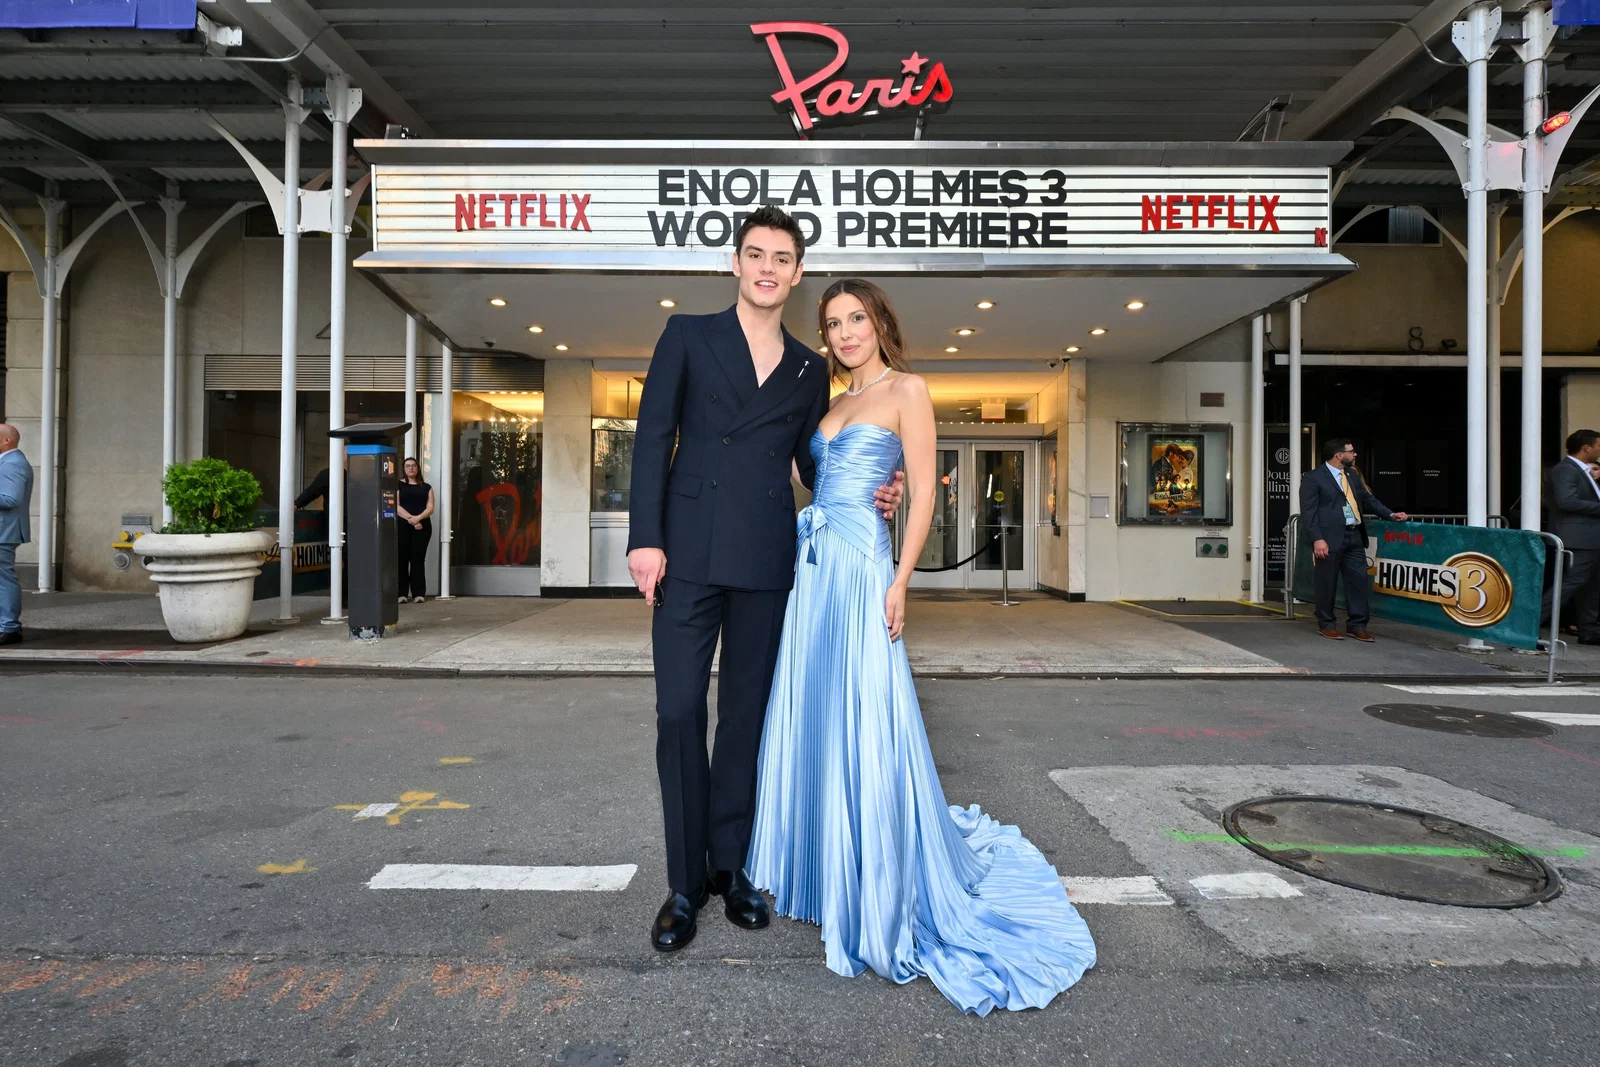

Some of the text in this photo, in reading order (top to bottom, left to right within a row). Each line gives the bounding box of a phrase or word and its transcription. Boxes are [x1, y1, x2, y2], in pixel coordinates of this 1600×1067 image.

[750, 21, 953, 130] Paris
[658, 168, 1067, 207] ENOLA HOLMES 3
[455, 193, 592, 232] NETFLIX
[647, 211, 1068, 248] WOD PREMIERE
[1141, 195, 1281, 233] NETFLIX
[1314, 227, 1327, 247] N
[1408, 326, 1424, 350] 8
[1384, 530, 1424, 546] NETFLIX
[1378, 561, 1487, 613] HOLMES 3
